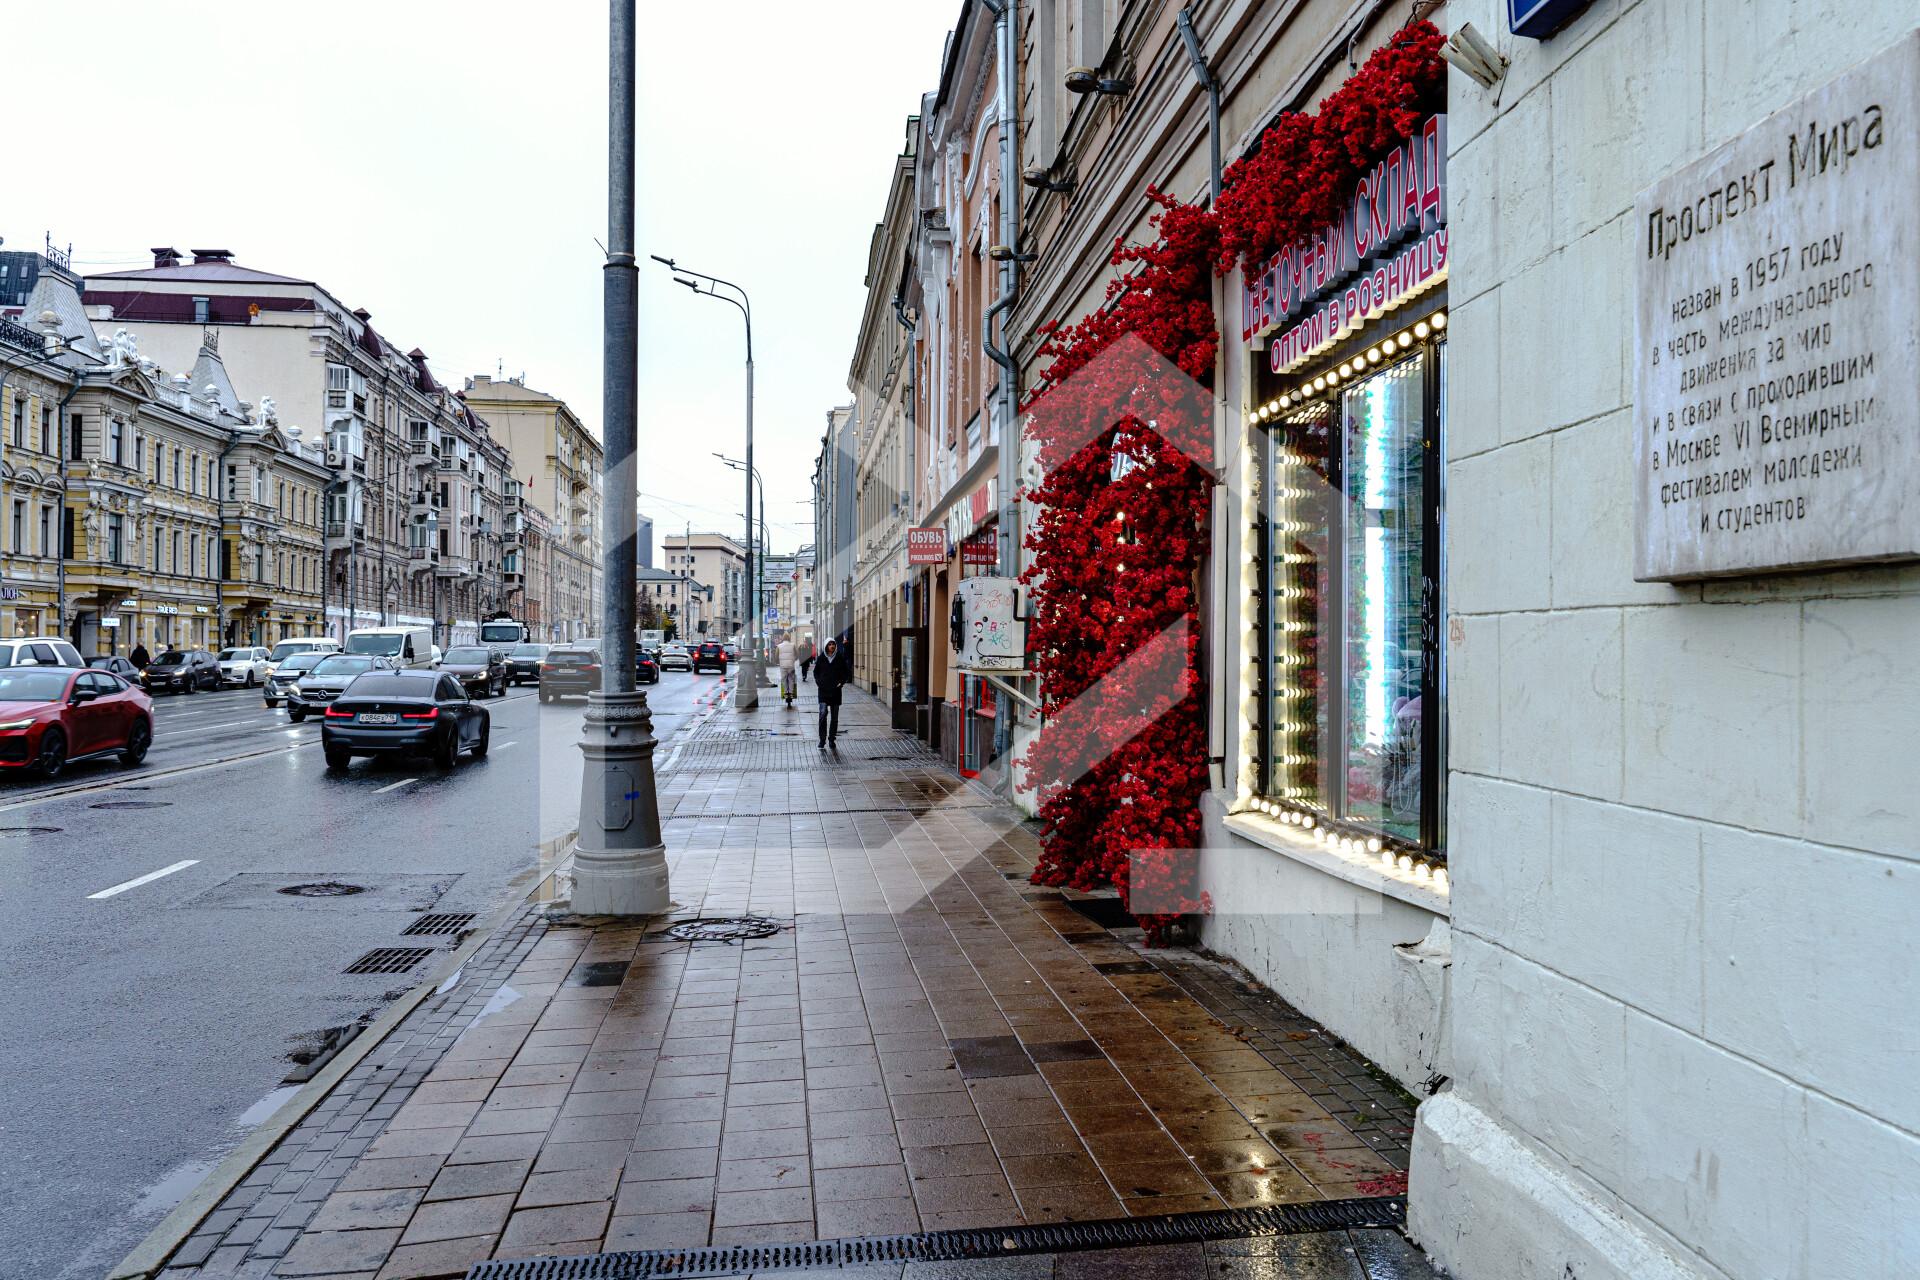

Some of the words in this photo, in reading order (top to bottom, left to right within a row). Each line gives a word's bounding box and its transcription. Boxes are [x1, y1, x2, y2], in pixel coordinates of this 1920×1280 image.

[1354, 113, 1440, 259] СКЛАД
[1648, 160, 1775, 260] Проспект
[1789, 104, 1883, 188] Мира
[1271, 308, 1324, 374] ОПТОМ
[1328, 299, 1340, 338] В
[1345, 224, 1448, 327] РОЗНИЦУ
[1672, 285, 1721, 323] назван
[1731, 277, 1739, 298] в
[1746, 246, 1790, 292] 1957
[1801, 231, 1843, 271] году
[1652, 345, 1660, 366] в
[1668, 329, 1707, 359] честь
[1680, 348, 1756, 395] движения
[1767, 337, 1784, 364] за
[1653, 416, 1660, 437] и
[1668, 412, 1675, 432] в
[1682, 396, 1721, 427] связи
[1731, 391, 1737, 413] с
[1747, 351, 1874, 412] проходившим
[1653, 451, 1659, 471] в
[1667, 433, 1721, 468] Москве
[1734, 420, 1750, 451] VI
[1761, 397, 1875, 445] Всемирным
[1661, 466, 1752, 508] фестивалем
[1764, 444, 1862, 485] молодежи
[910, 531, 942, 544] ОБУВЬ
[1701, 513, 1709, 534] и
[1717, 496, 1806, 534] студентов
